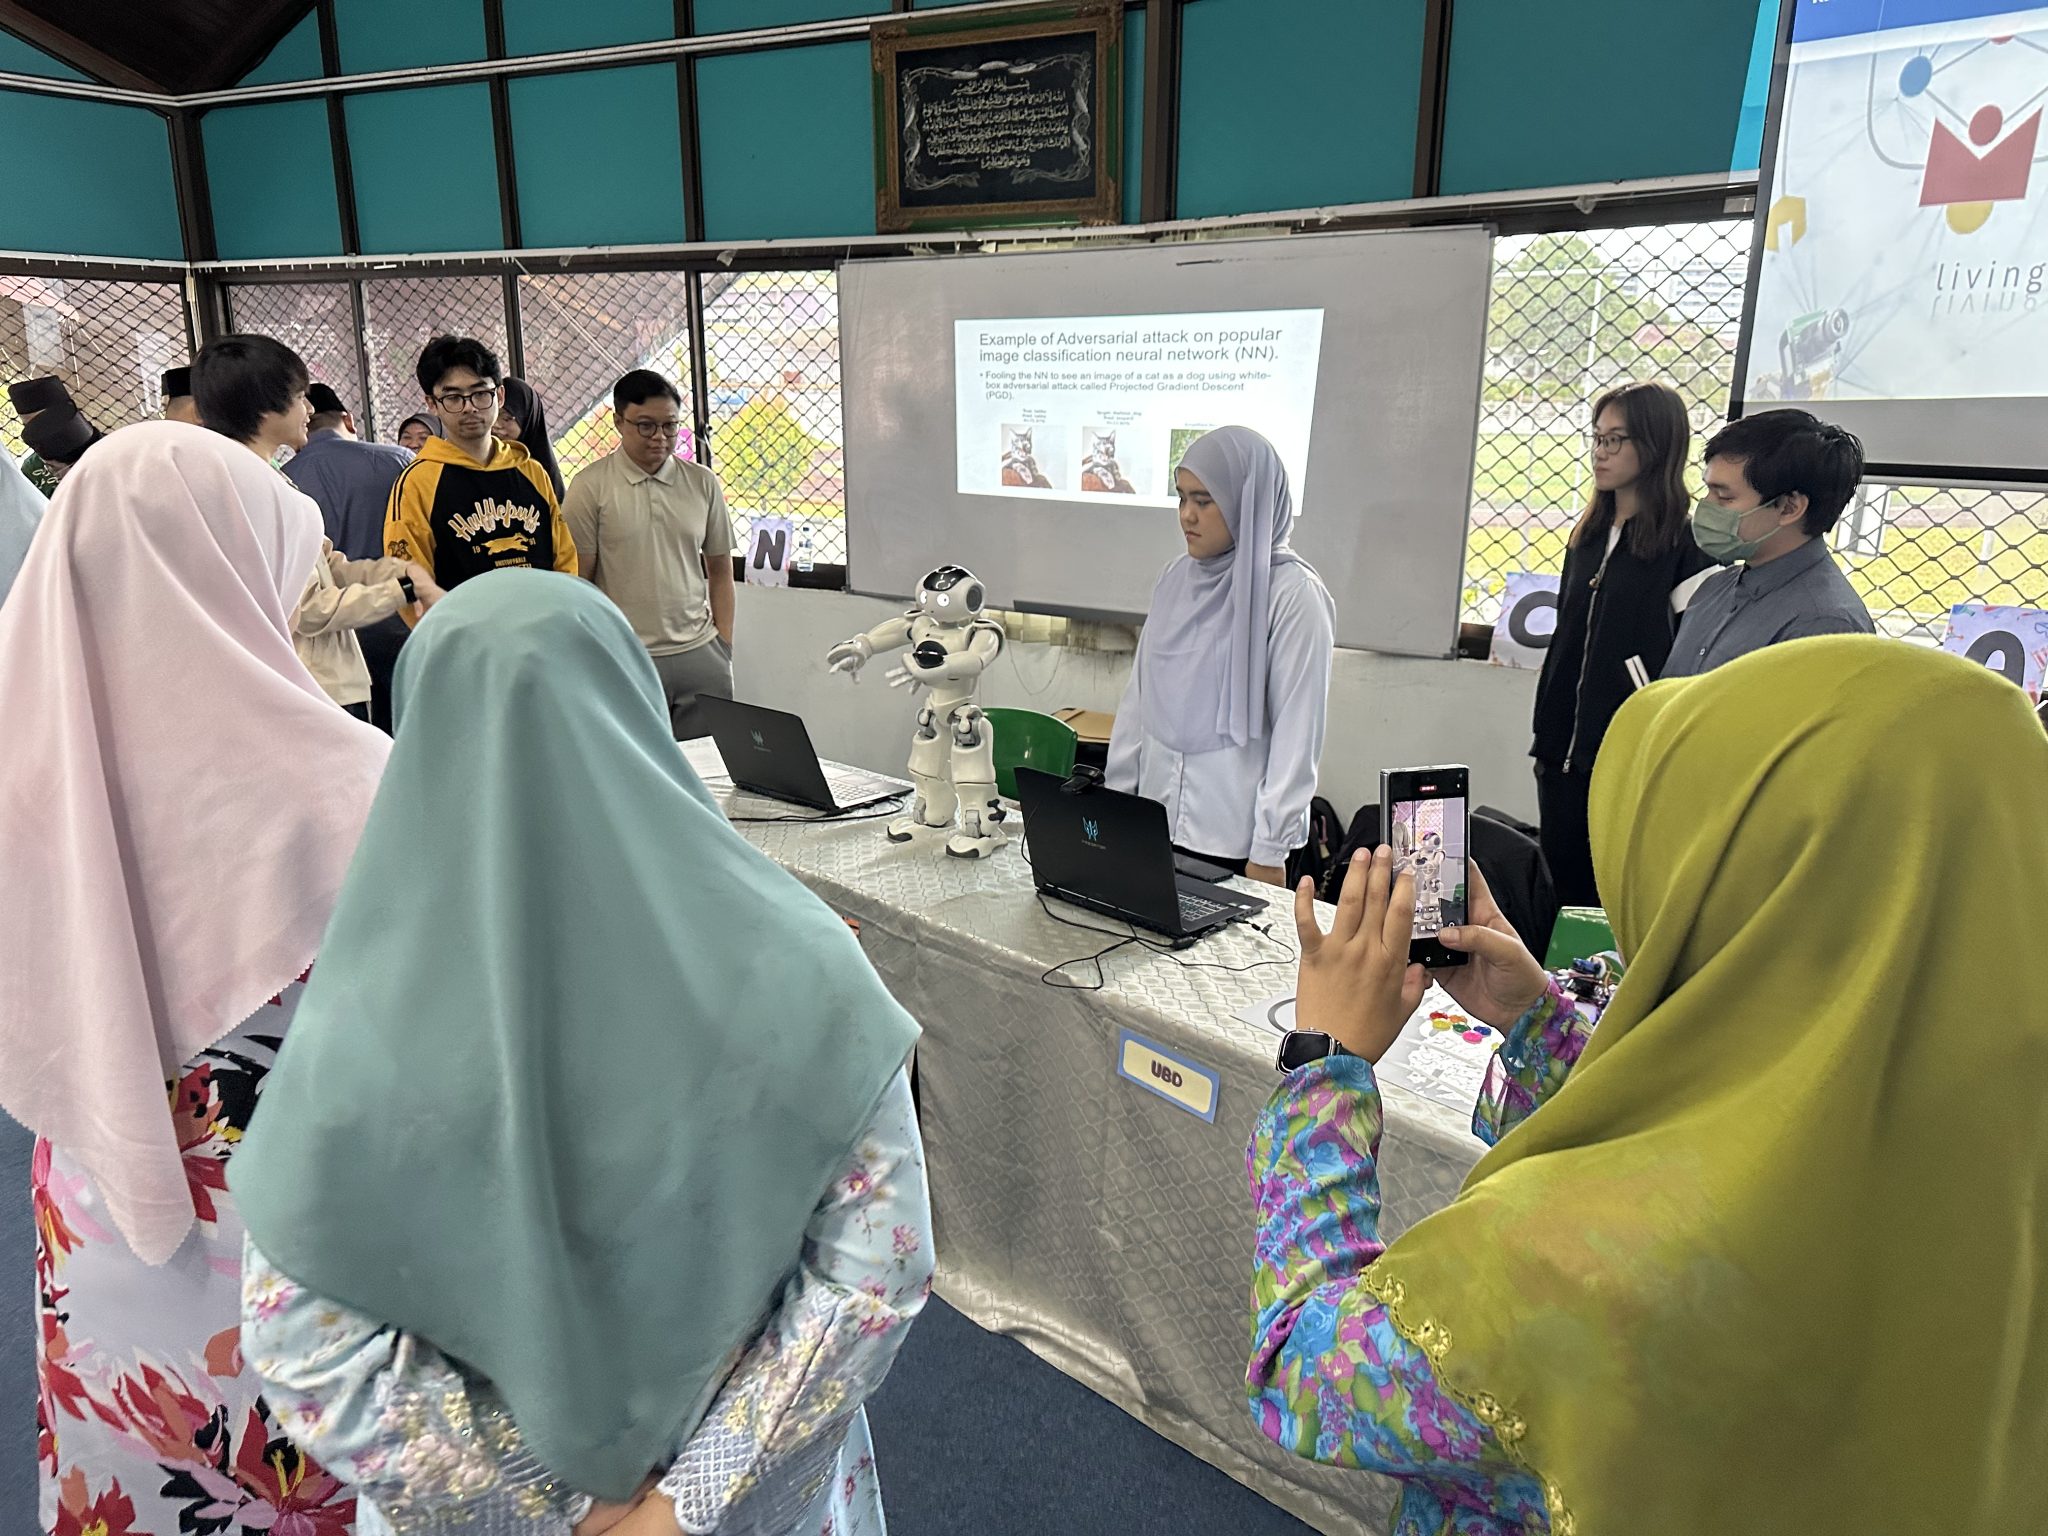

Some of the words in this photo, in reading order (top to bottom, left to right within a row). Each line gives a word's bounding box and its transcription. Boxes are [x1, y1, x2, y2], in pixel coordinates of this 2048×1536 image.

[1937, 260, 2047, 294] living
[979, 333, 1037, 348] Example
[1040, 332, 1056, 345] of
[1057, 331, 1138, 345] Adversarial
[1142, 330, 1189, 344] attack
[1193, 331, 1213, 343] on
[1218, 327, 1283, 345] popular
[979, 350, 1019, 364] image
[1023, 348, 1111, 362] classification
[1116, 348, 1162, 361] neural
[1167, 347, 1229, 361] network
[1235, 345, 1279, 362] (NN).
[985, 370, 1016, 381] Fooling
[1018, 371, 1031, 380] the
[1034, 371, 1048, 380] NN
[1050, 371, 1059, 380] to
[1061, 372, 1077, 380] see
[1094, 371, 1122, 381] image
[1124, 371, 1134, 380] of
[1145, 371, 1160, 380] cat
[1186, 371, 1205, 381] dog
[1208, 371, 1236, 381] using
[985, 382, 1000, 390] box
[1003, 382, 1049, 390] adversarial
[1052, 382, 1077, 390] attack
[1080, 382, 1106, 391] called
[1109, 382, 1154, 392] Projected
[1157, 382, 1199, 391] Gradient
[1202, 382, 1244, 391] Descent
[753, 529, 786, 571] N
[1151, 1060, 1183, 1087] UBD
